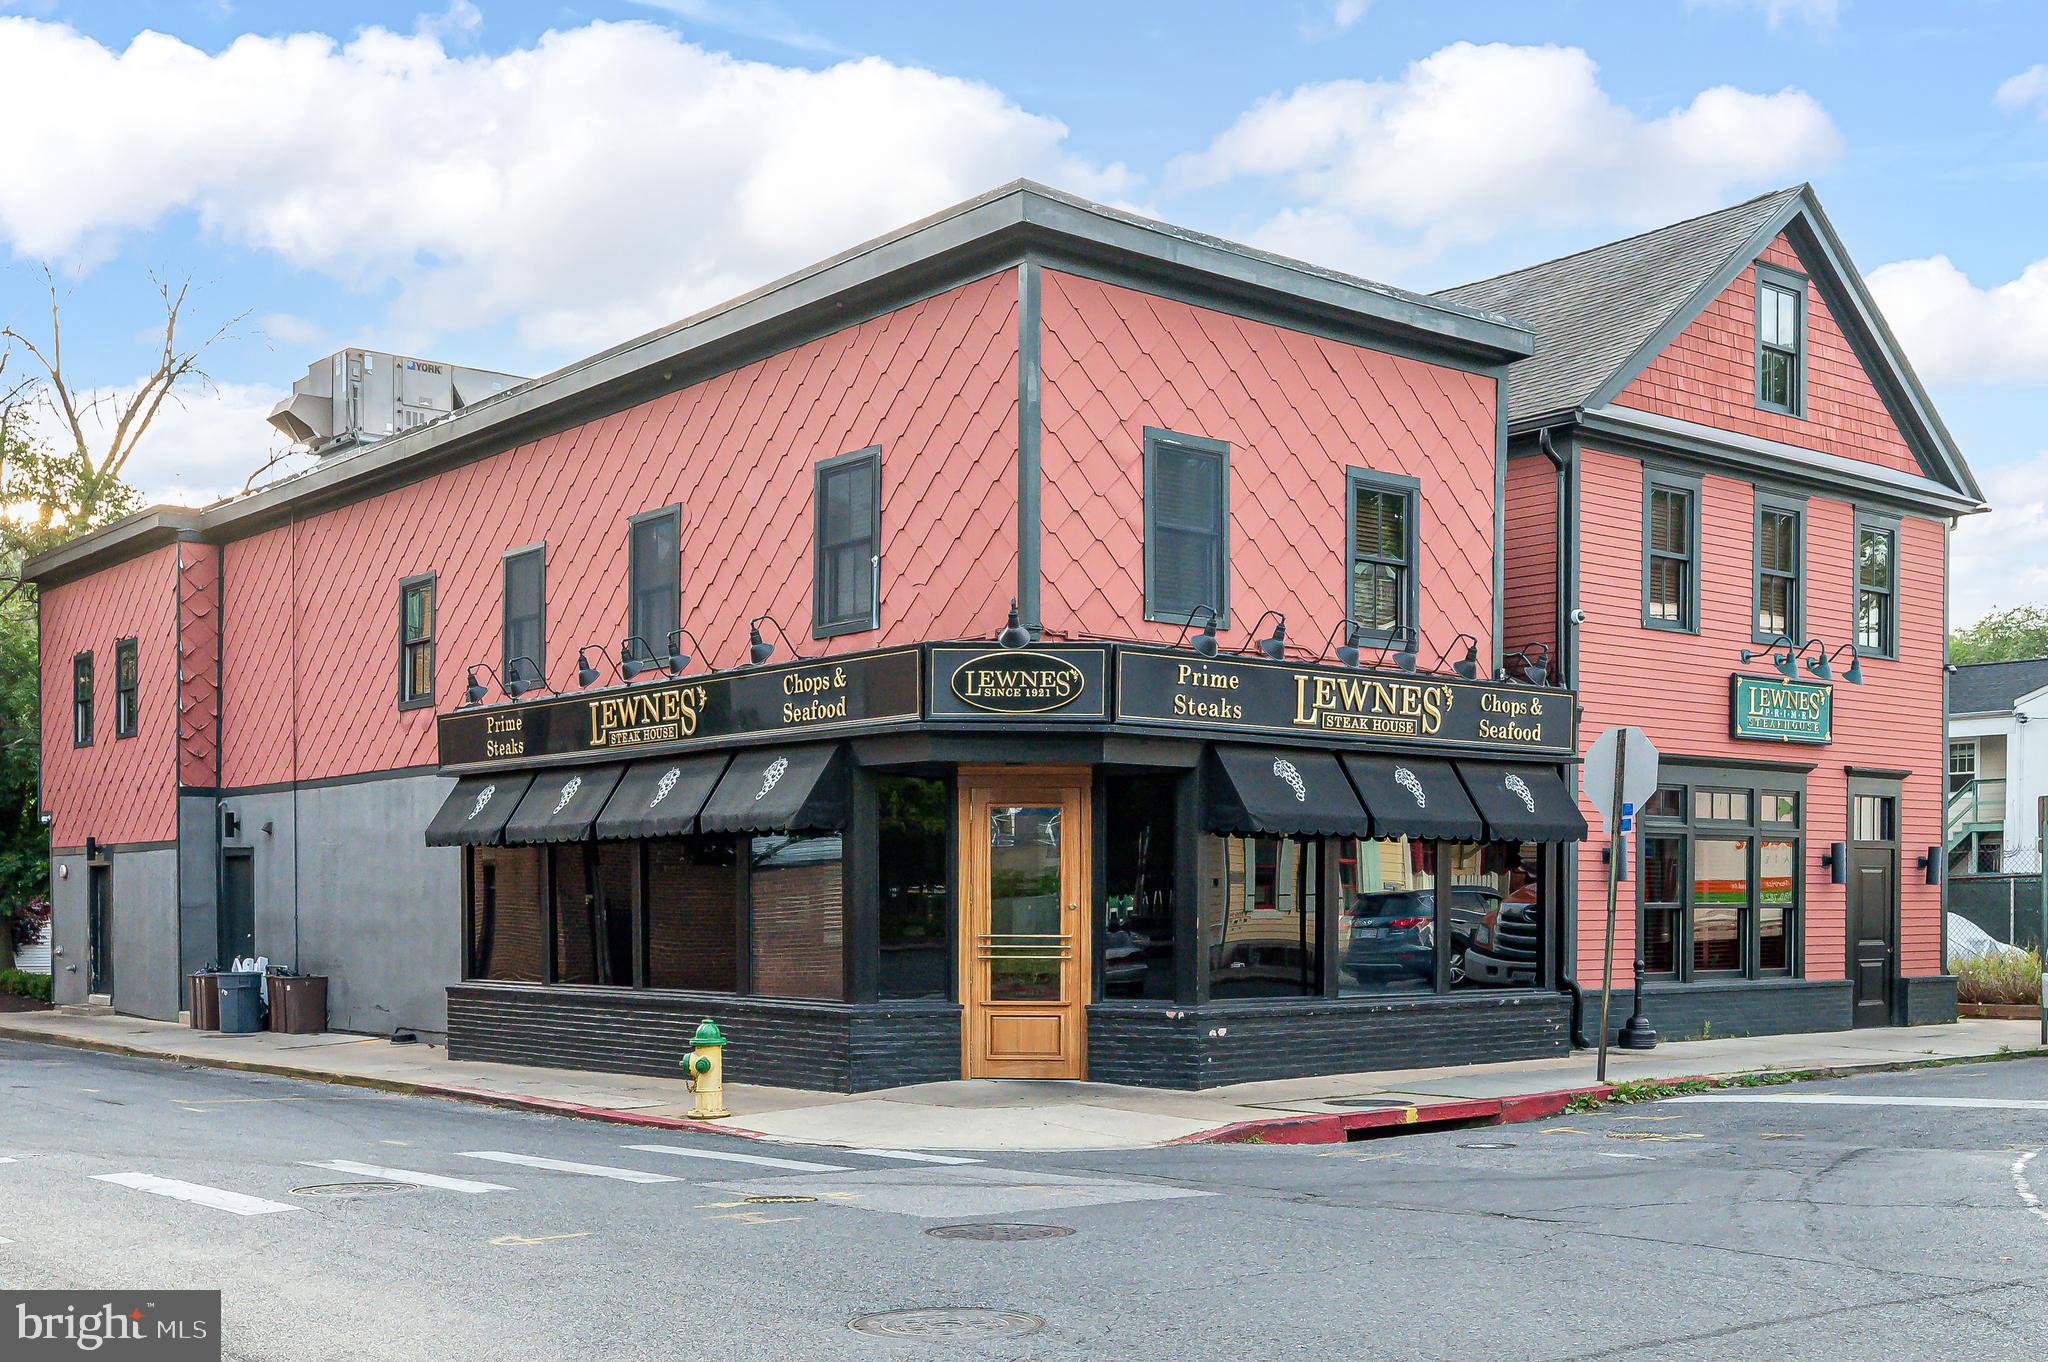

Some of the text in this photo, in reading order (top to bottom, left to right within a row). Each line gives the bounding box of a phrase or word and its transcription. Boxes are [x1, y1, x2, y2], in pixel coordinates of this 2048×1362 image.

[416, 362, 441, 374] YORK
[783, 667, 847, 695] Chops &
[1177, 664, 1239, 689] Prime
[984, 688, 1050, 697] SINCE 1921
[783, 696, 847, 723] Seafood
[1174, 693, 1242, 719] Steaks
[1480, 693, 1543, 717] Chops &
[487, 715, 523, 734] Prime
[1326, 715, 1414, 734] STEAK HOUSE
[1479, 719, 1542, 741] Seafood
[1748, 718, 1820, 732] STEAKHOUSE
[610, 727, 675, 744] STEAK HOUSE
[487, 739, 524, 757] Steaks
